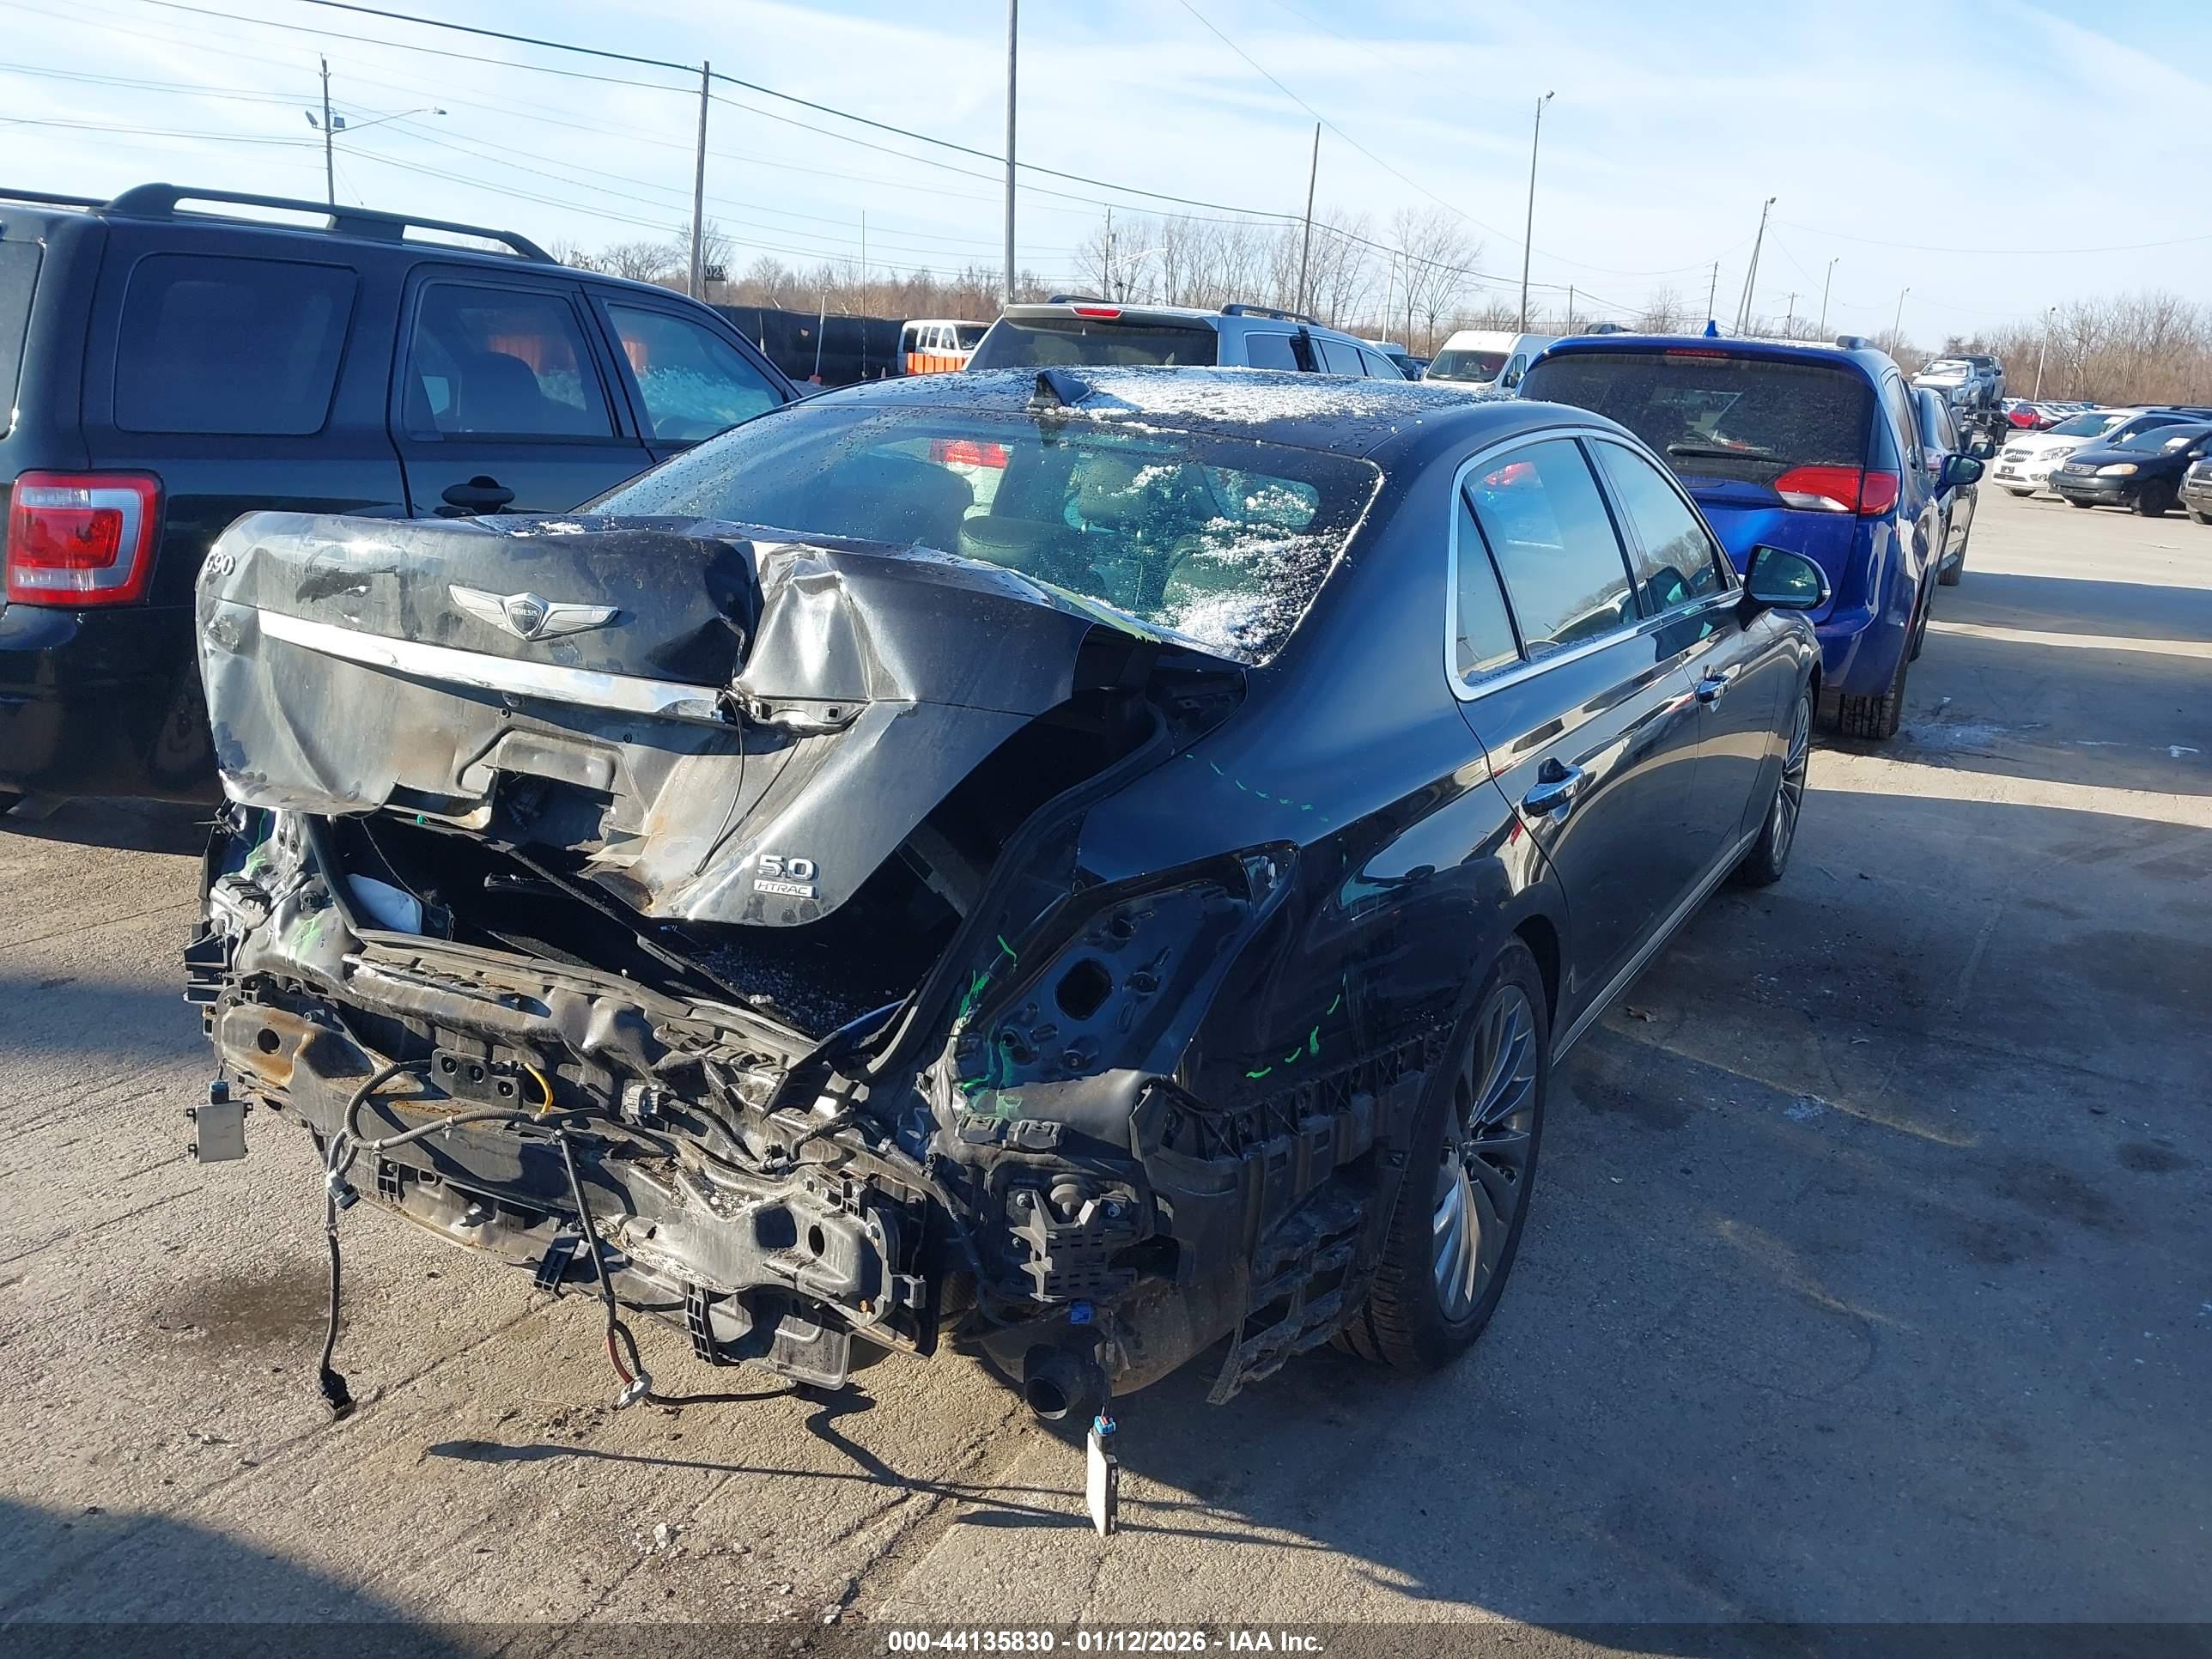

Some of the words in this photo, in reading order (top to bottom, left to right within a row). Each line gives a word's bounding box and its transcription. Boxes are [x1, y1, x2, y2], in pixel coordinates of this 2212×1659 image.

[511, 607, 538, 617] GENESIS
[757, 854, 815, 880] 5.0
[757, 881, 809, 895] HTRAC
